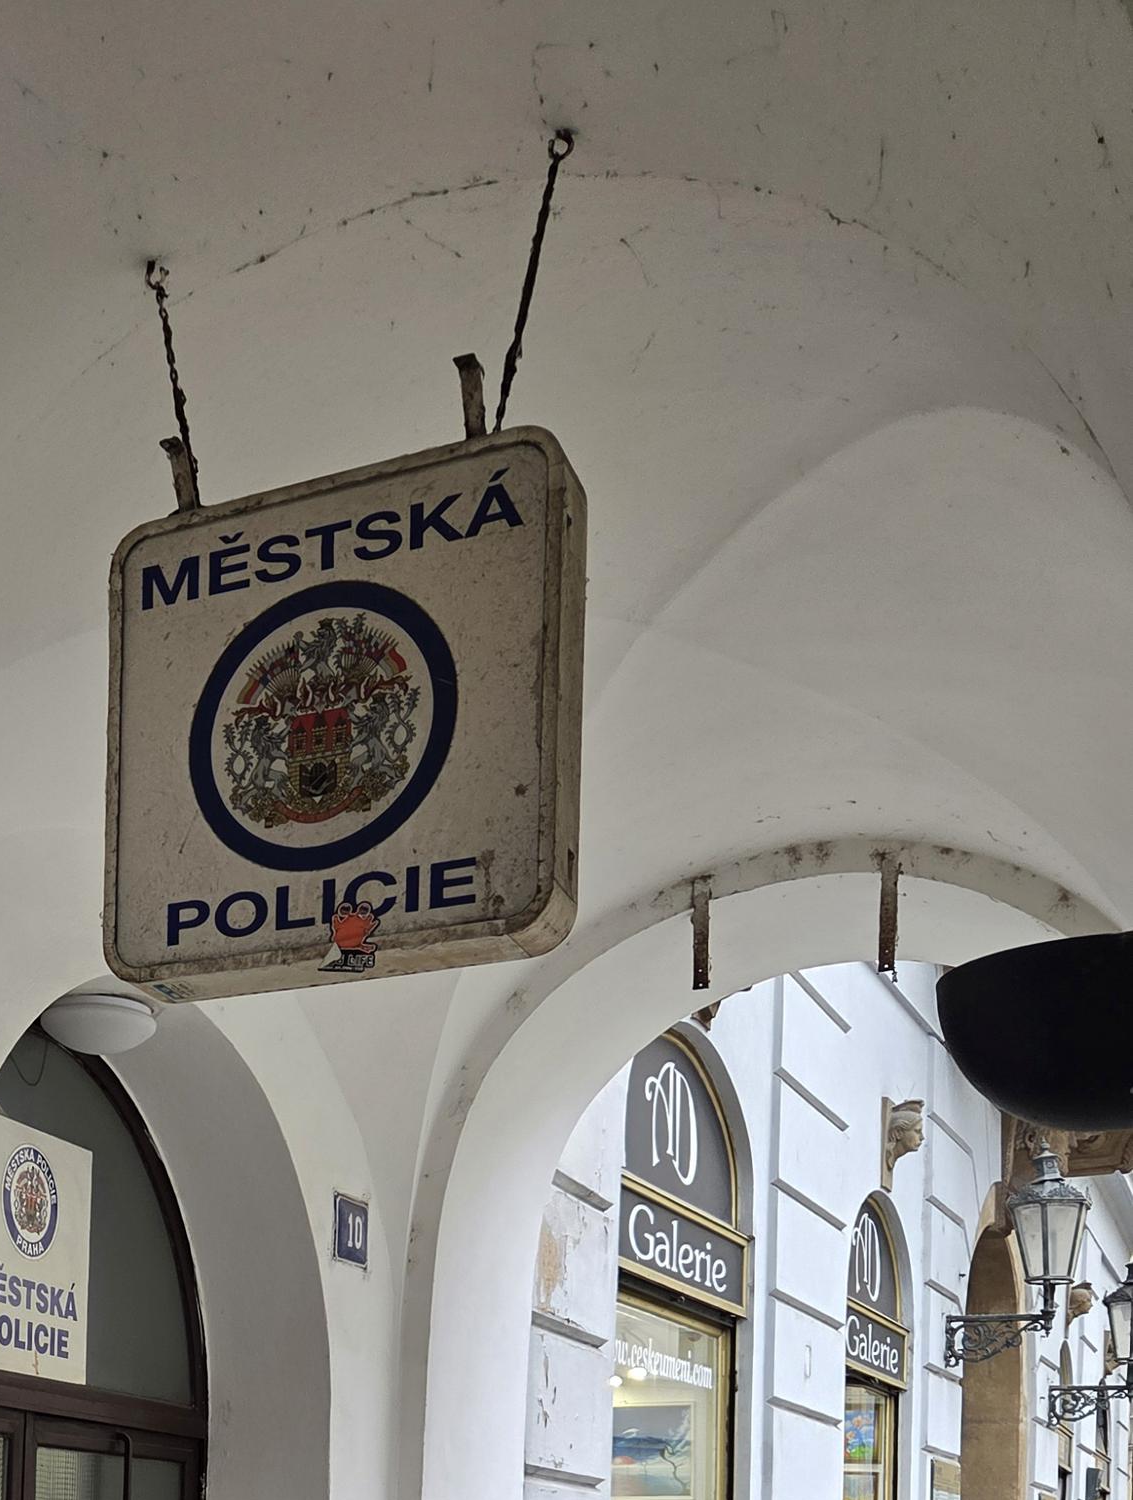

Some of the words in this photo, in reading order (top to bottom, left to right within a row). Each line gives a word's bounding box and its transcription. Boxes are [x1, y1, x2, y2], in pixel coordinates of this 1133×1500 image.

[140, 467, 524, 611] MĚSTSKÁ
[165, 856, 477, 947] POLICIE
[36, 1154, 57, 1205] POLICIE
[15, 1234, 45, 1256] PRAHA
[347, 1213, 363, 1250] 10
[628, 1203, 728, 1293] Galerie
[845, 1314, 899, 1374] Galerie
